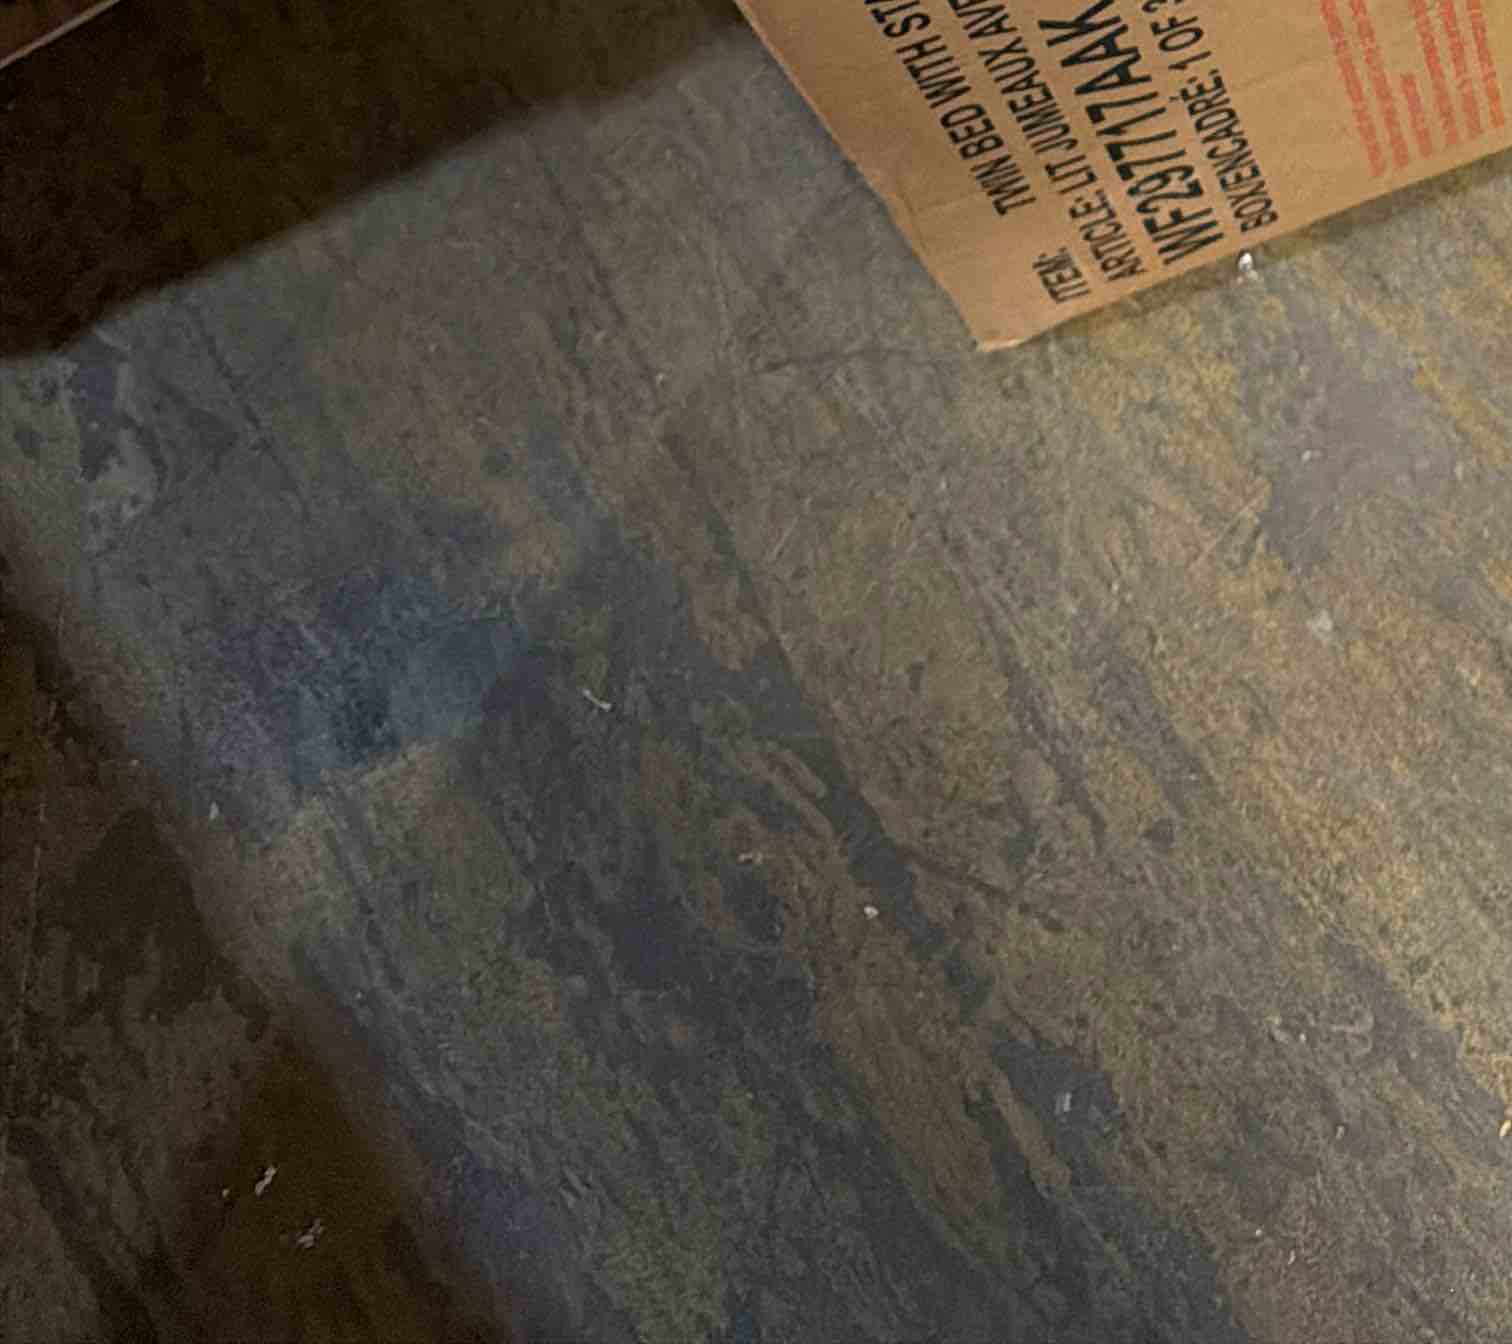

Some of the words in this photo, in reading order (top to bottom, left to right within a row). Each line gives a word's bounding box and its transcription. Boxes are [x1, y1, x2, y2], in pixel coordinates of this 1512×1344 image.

[1152, 16, 1204, 51] OF
[1168, 51, 1211, 70] 1
[896, 35, 971, 108] WITH
[978, 37, 1077, 153] JUMEAUX
[941, 103, 1004, 160] BED
[970, 154, 1036, 217] TWIN
[1045, 155, 1098, 195] LIT
[1069, 189, 1146, 282] ARTICLE:
[1032, 247, 1091, 303] ITEM:
